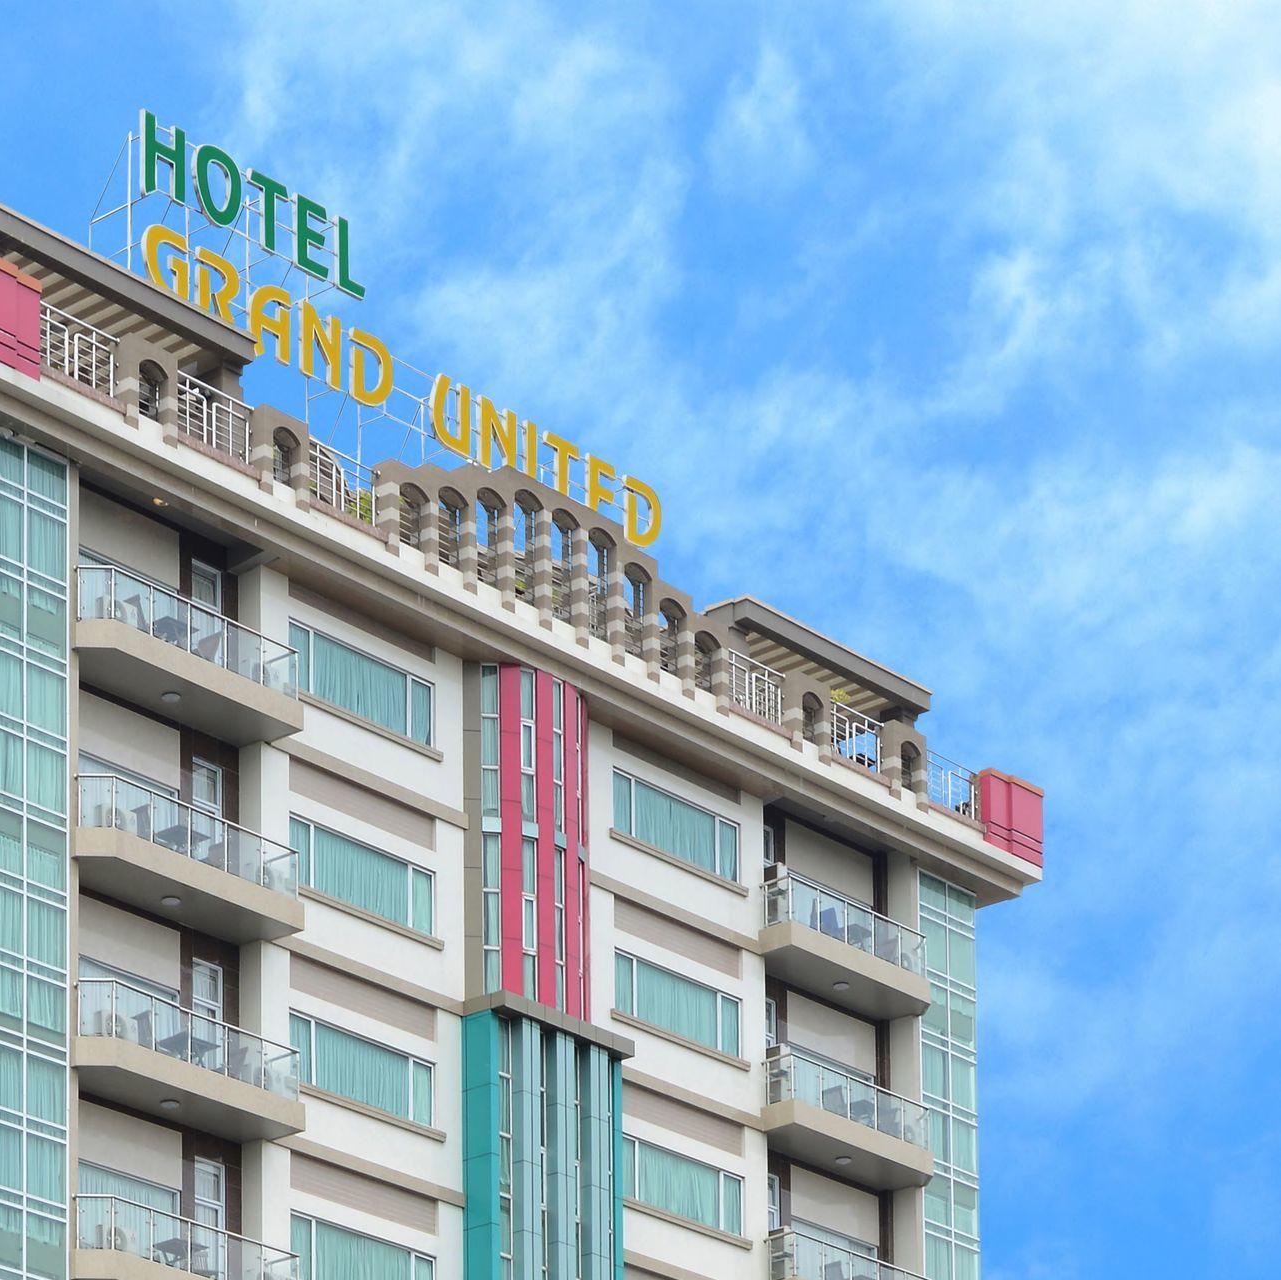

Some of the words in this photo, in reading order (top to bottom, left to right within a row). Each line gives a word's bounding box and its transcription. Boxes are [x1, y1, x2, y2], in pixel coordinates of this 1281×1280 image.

[139, 108, 366, 300] HOTEL
[141, 224, 394, 407] GRAND
[428, 373, 662, 548] UNITED
